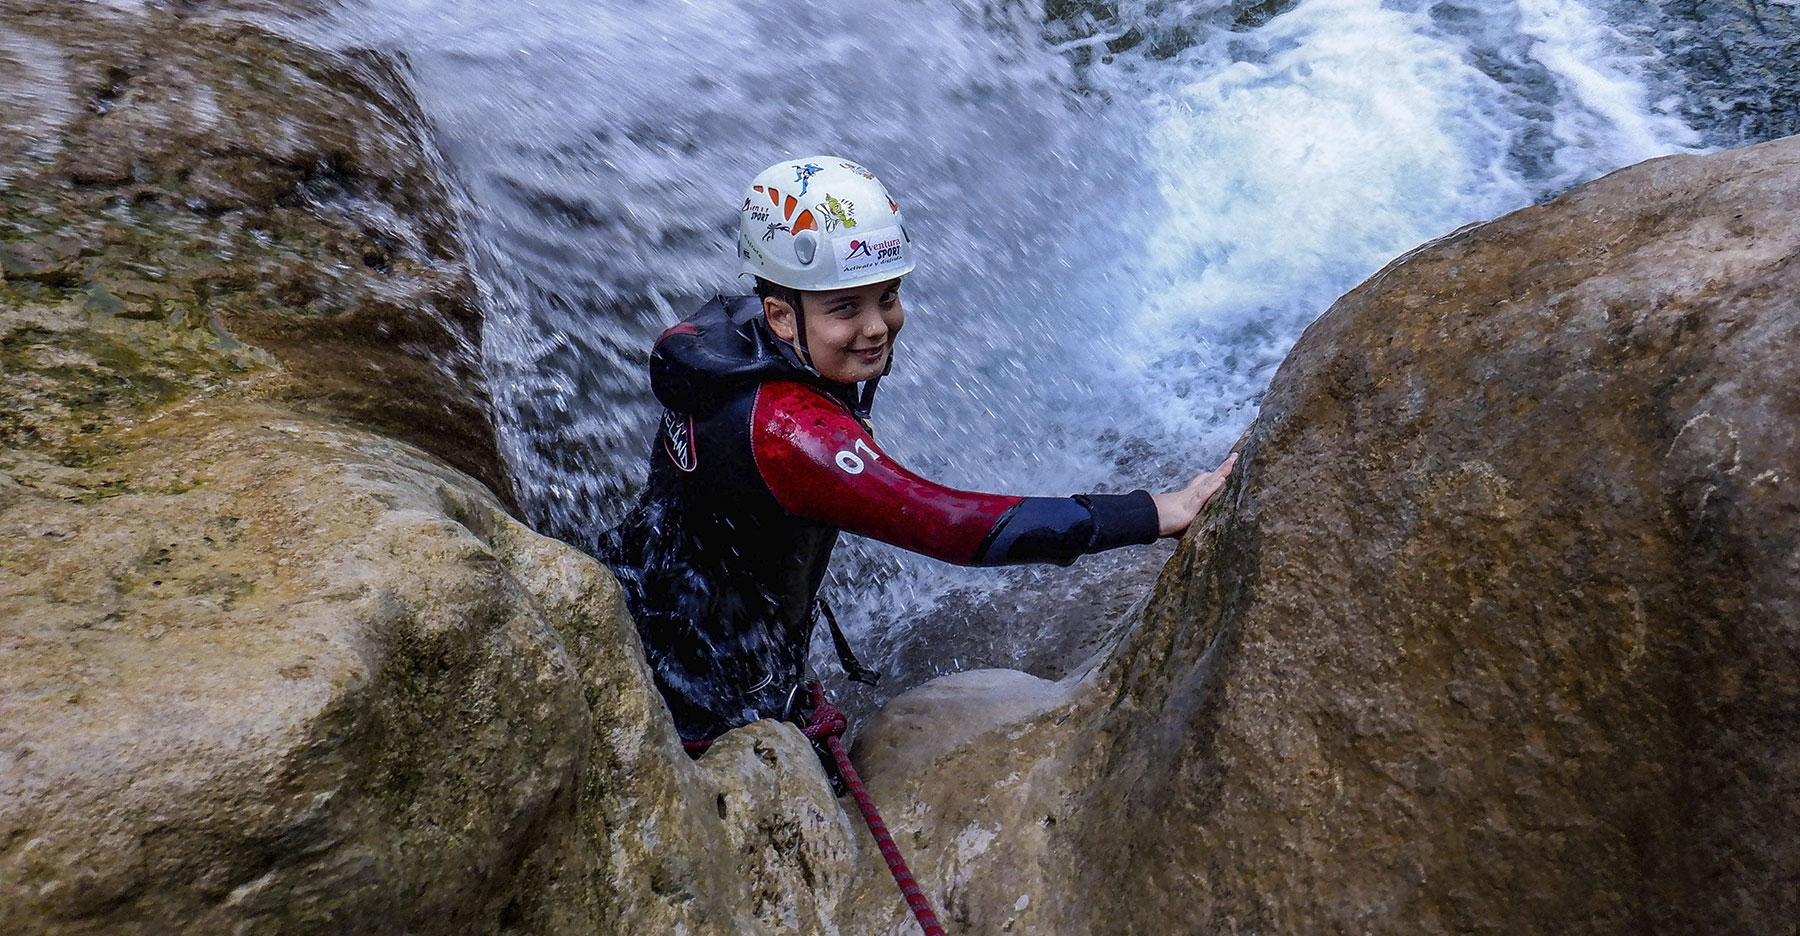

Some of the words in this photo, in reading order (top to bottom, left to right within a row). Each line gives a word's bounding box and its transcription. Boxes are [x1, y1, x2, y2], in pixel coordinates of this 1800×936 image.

[844, 238, 901, 260] Aventura
[878, 246, 901, 260] SPORT
[835, 438, 880, 474] 01
